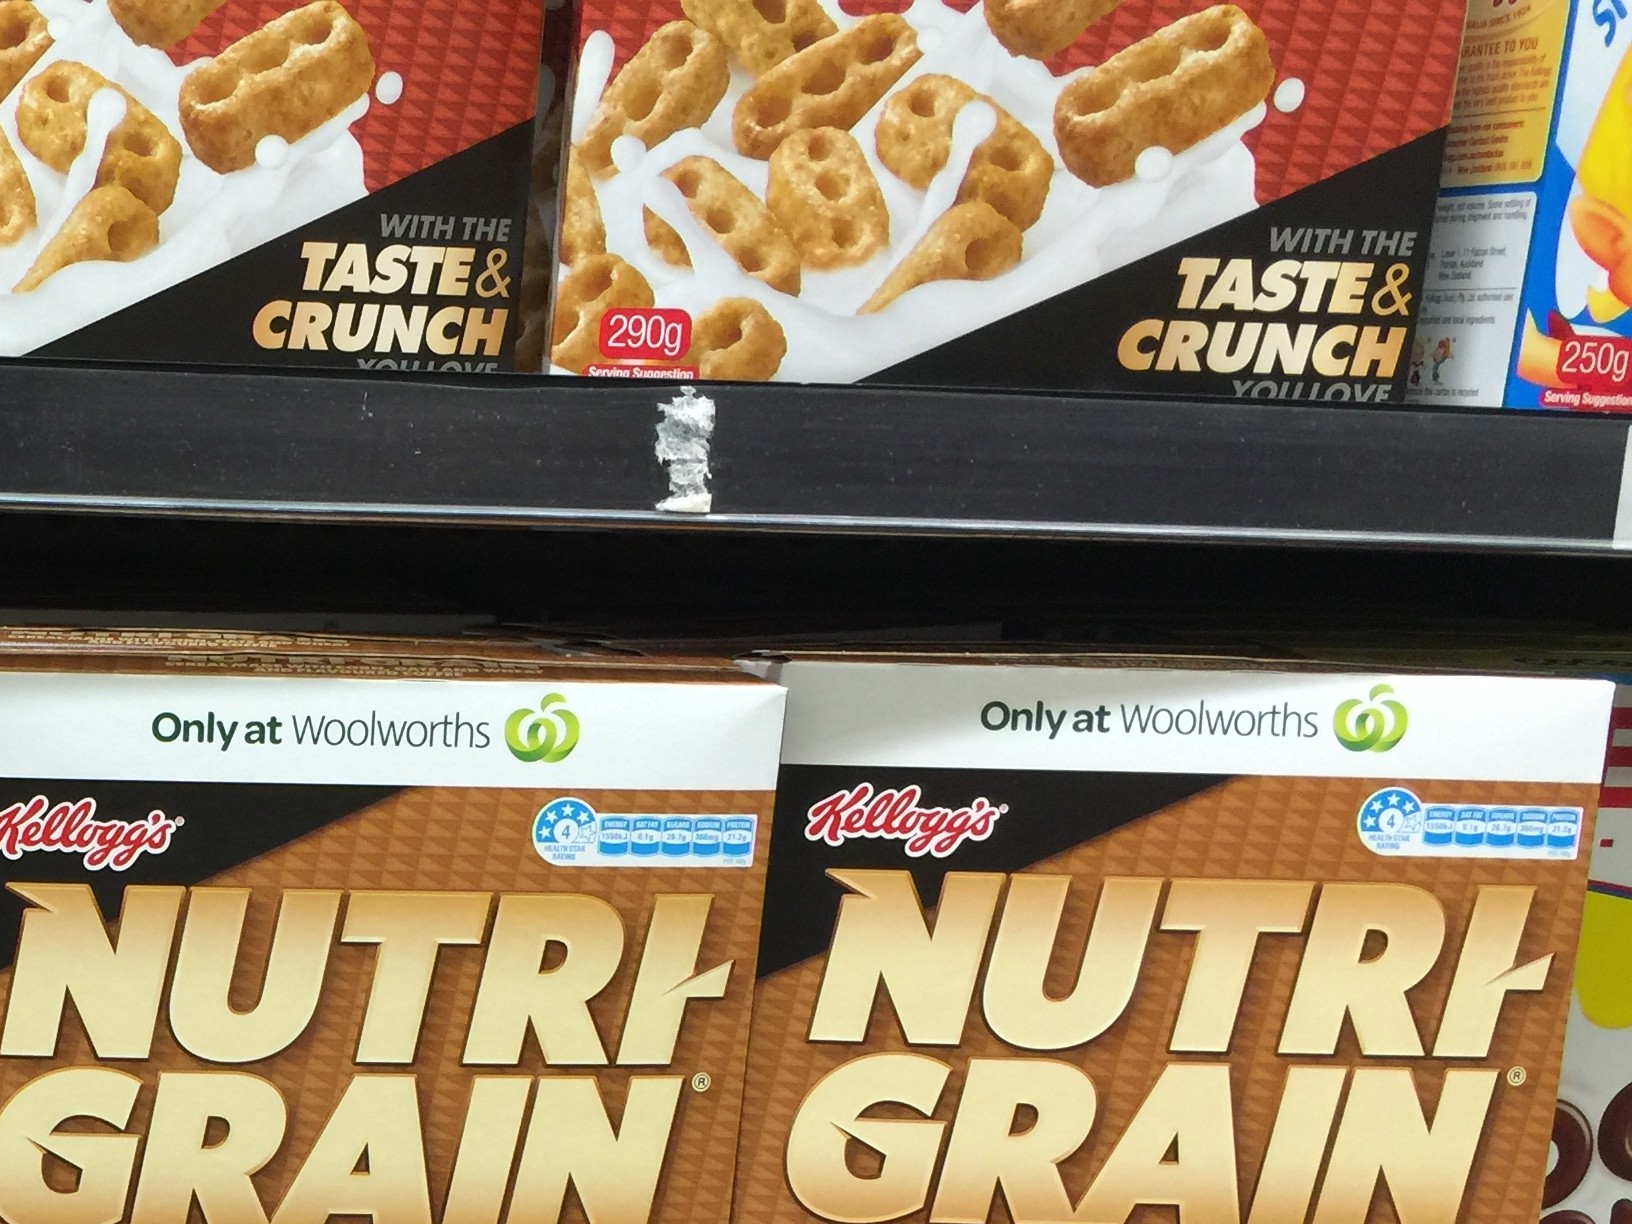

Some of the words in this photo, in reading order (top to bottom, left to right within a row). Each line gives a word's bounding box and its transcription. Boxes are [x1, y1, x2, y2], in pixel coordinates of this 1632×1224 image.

[1520, 37, 1539, 50] YOU
[380, 213, 454, 239] WITH
[462, 218, 512, 242] THE
[1270, 227, 1353, 254] WITH
[1361, 230, 1418, 257] THE
[252, 300, 509, 356] CRUNCH
[608, 314, 682, 356] 290g
[1117, 319, 1407, 377] CRUNCH
[1562, 341, 1630, 382] 250g
[1544, 390, 1579, 405] Serving
[151, 712, 238, 753] Only
[244, 714, 283, 746] at
[291, 711, 492, 751] Woolworths
[979, 701, 1068, 742] Only
[1073, 702, 1111, 735] at
[1119, 701, 1320, 741] Woolworths
[805, 781, 999, 858] Kellogg's
